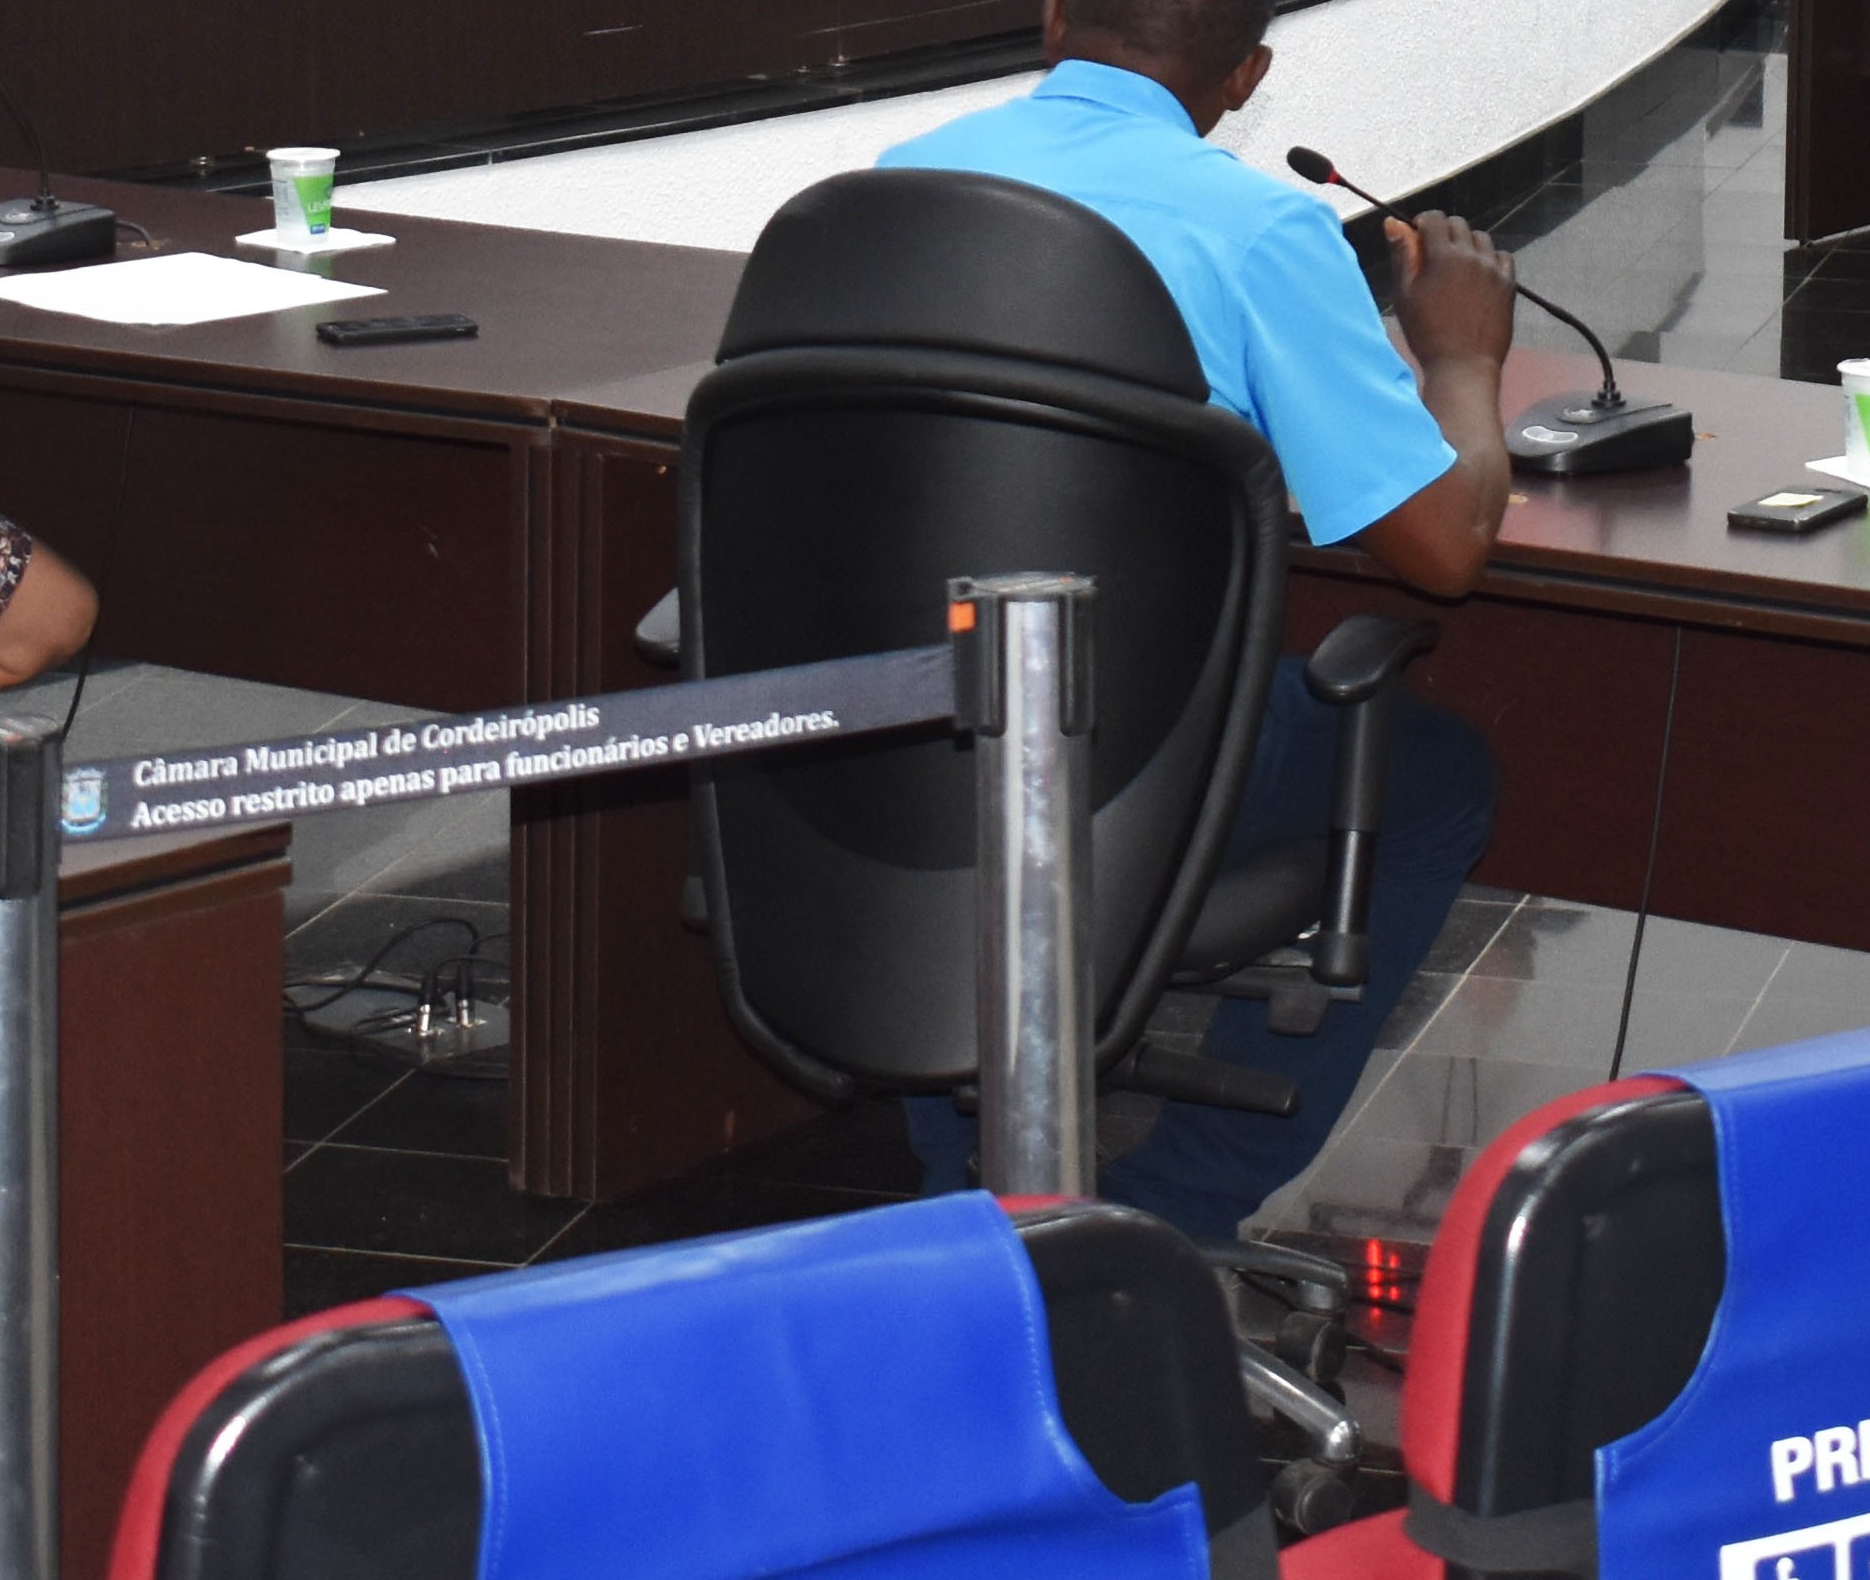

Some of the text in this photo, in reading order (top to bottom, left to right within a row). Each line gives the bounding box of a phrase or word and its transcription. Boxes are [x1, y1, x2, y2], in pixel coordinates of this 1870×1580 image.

[131, 709, 840, 829] Acesso restrito apenas para funcionários e Vereadores.
[134, 703, 600, 787] Câmara Municipal de Cordeirópolis
